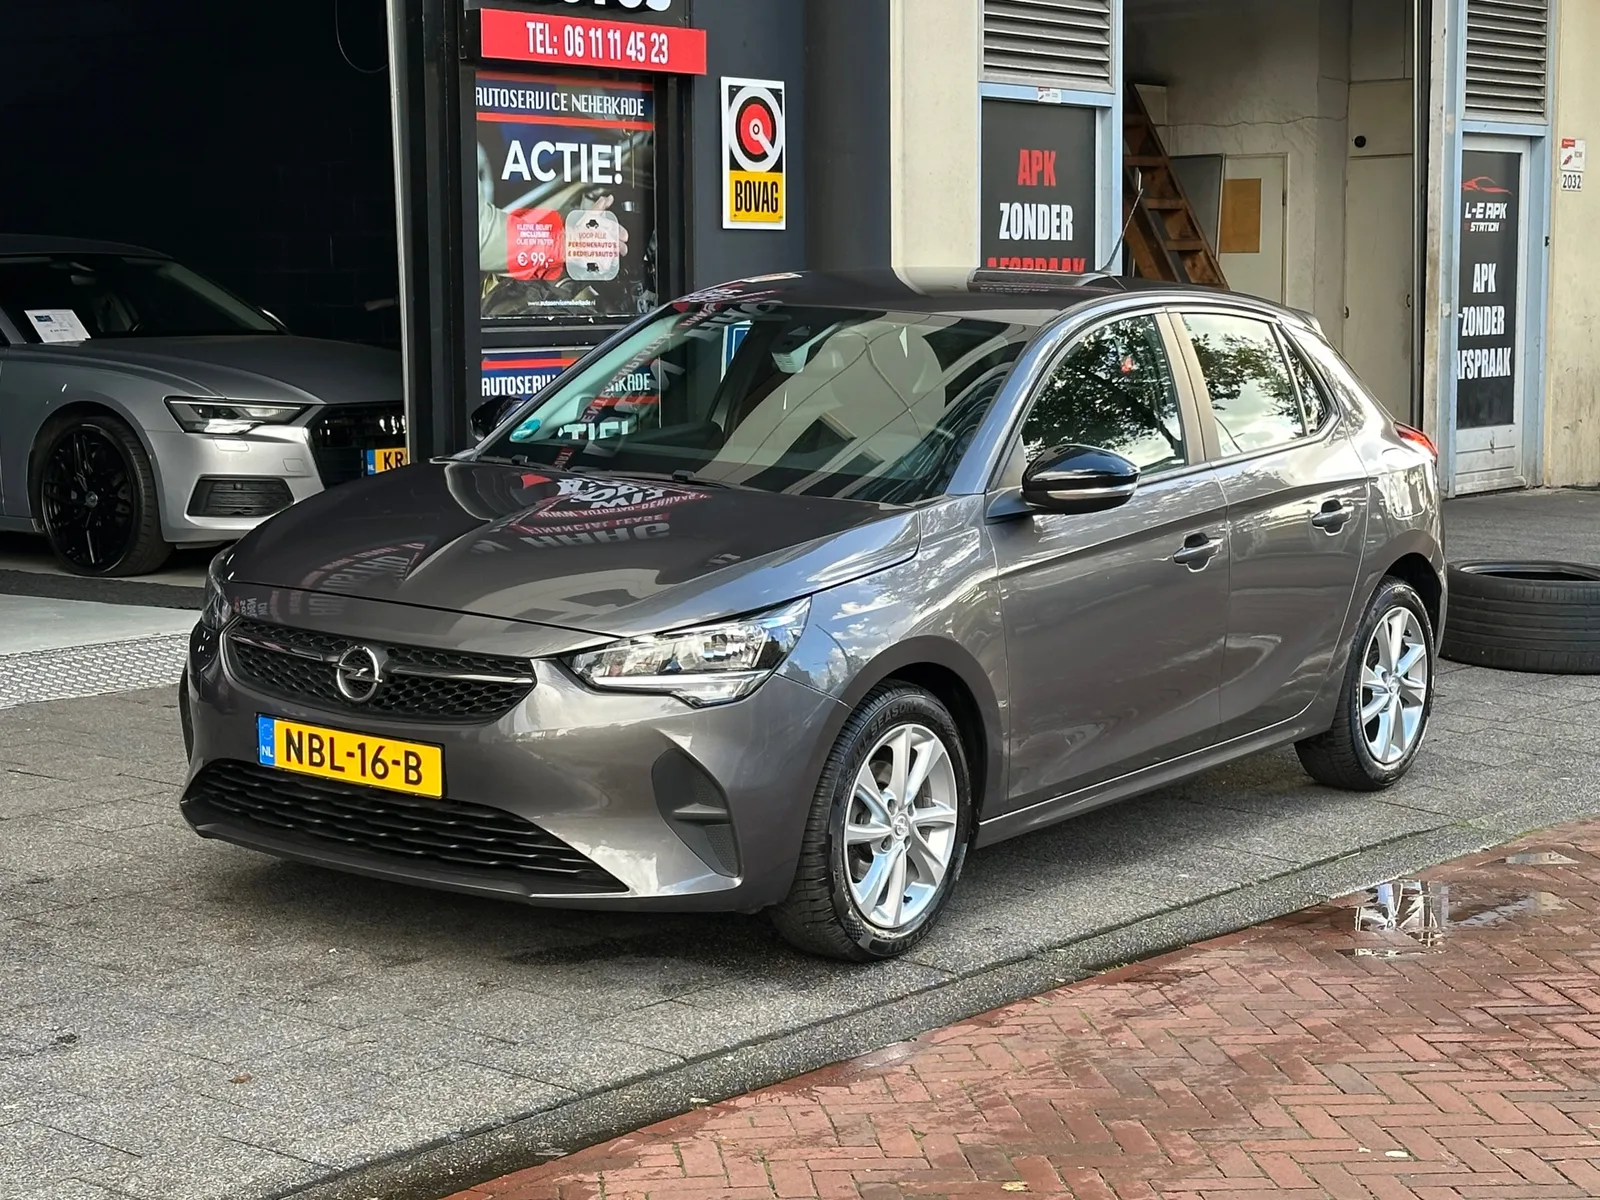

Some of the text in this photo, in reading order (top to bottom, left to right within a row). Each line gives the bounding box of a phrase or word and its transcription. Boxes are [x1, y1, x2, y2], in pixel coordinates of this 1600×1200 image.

[526, 21, 668, 64] TEL: 06 11 11 45 23
[476, 86, 644, 117] AUTOSERVICE NEHERKADE
[501, 140, 623, 185] ACTIE!
[1018, 149, 1056, 186] APK
[735, 180, 779, 214] BOVAG
[1563, 174, 1581, 189] 2032
[999, 202, 1073, 241] ZONDER
[1470, 221, 1500, 232] STATION
[1485, 203, 1508, 219] APK
[1473, 263, 1497, 293] APK
[1462, 306, 1505, 336] ZONDER
[261, 745, 274, 758] NL
[285, 728, 423, 786] NBL-16-B
